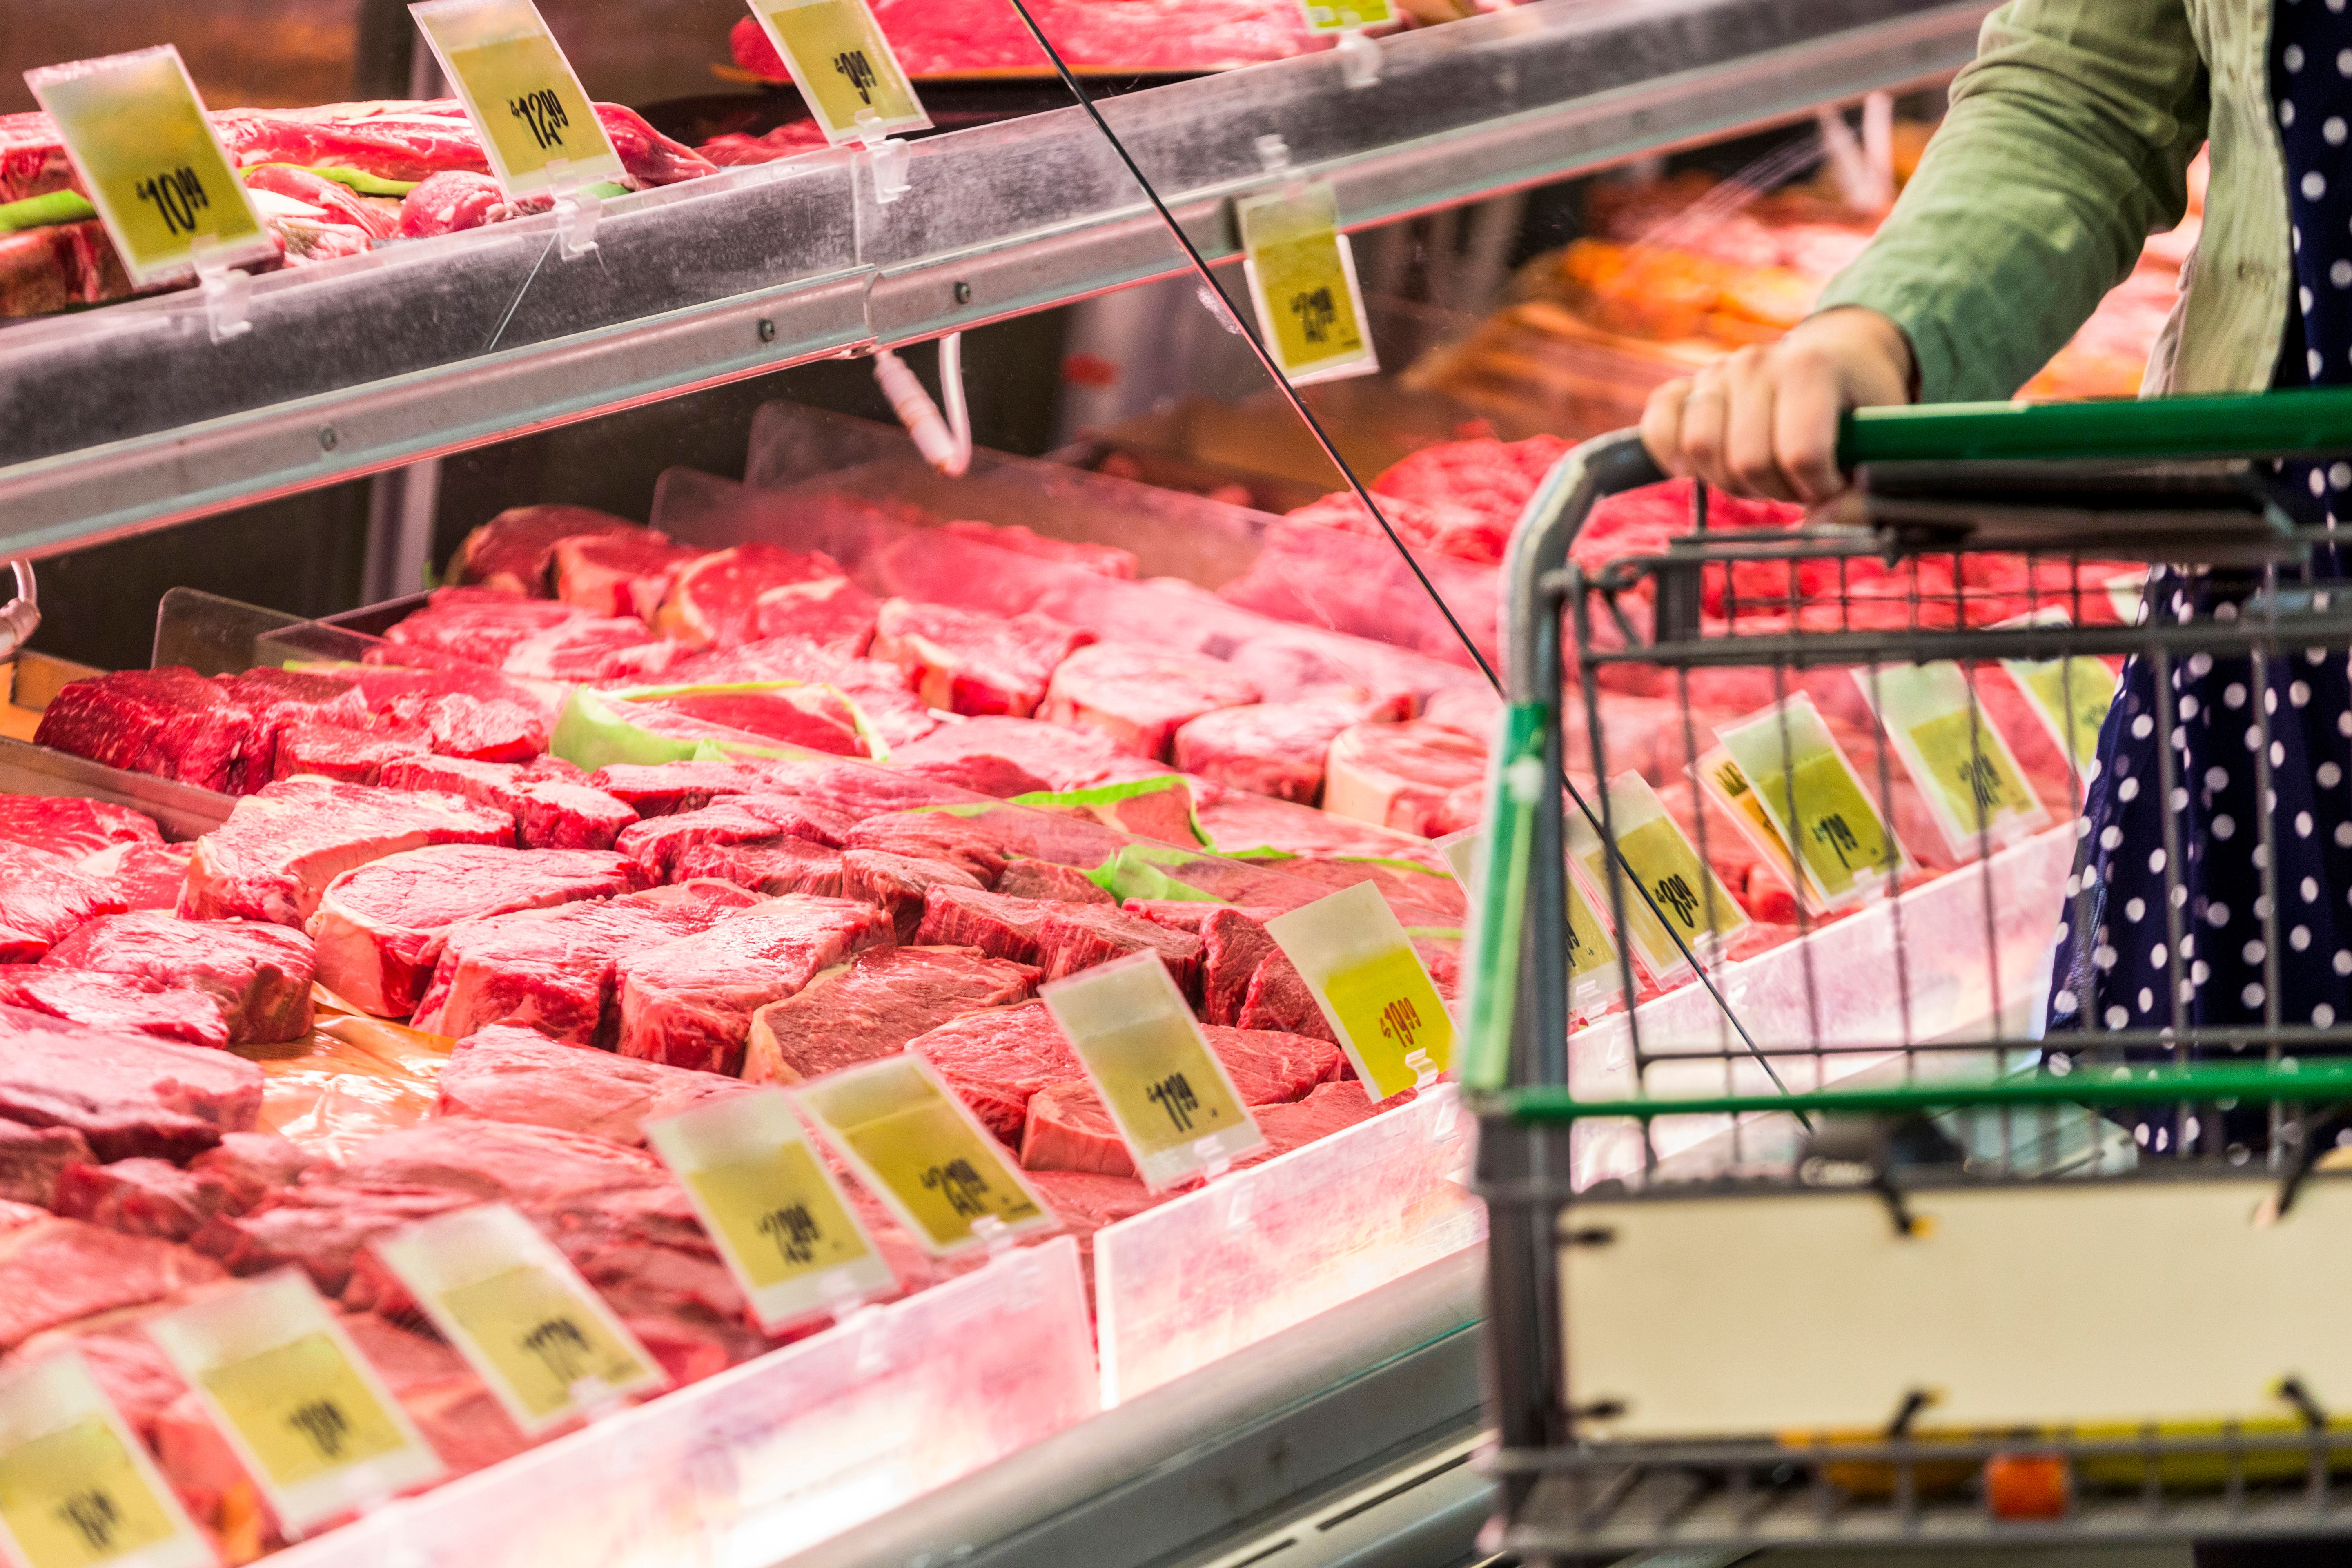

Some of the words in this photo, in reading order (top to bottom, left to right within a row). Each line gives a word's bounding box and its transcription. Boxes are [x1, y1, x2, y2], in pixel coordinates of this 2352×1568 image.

[507, 88, 569, 149] $1299
[1654, 873, 1699, 928] $899
[1379, 996, 1422, 1048] $1999
